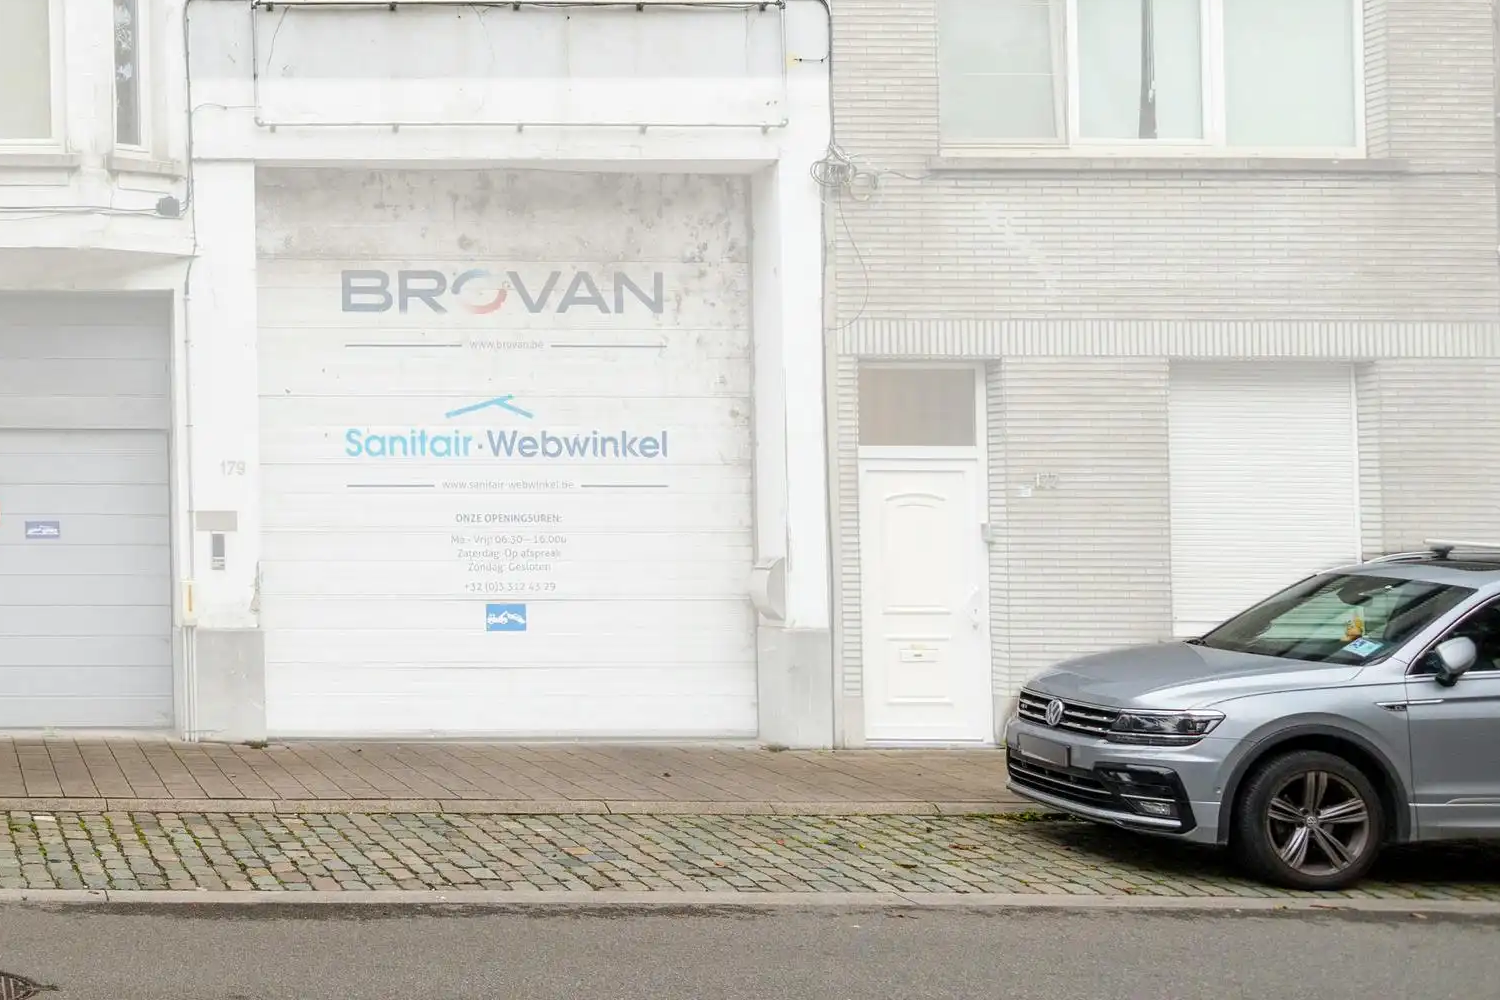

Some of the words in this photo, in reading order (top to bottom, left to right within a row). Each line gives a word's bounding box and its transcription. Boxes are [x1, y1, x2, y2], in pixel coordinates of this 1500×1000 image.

[341, 268, 664, 315] BROVAN
[469, 338, 545, 350] www.brovan.be
[345, 428, 473, 458] Sanitair
[487, 430, 668, 459] Webwinkel
[219, 460, 246, 476] 179
[455, 513, 482, 523] ONZE
